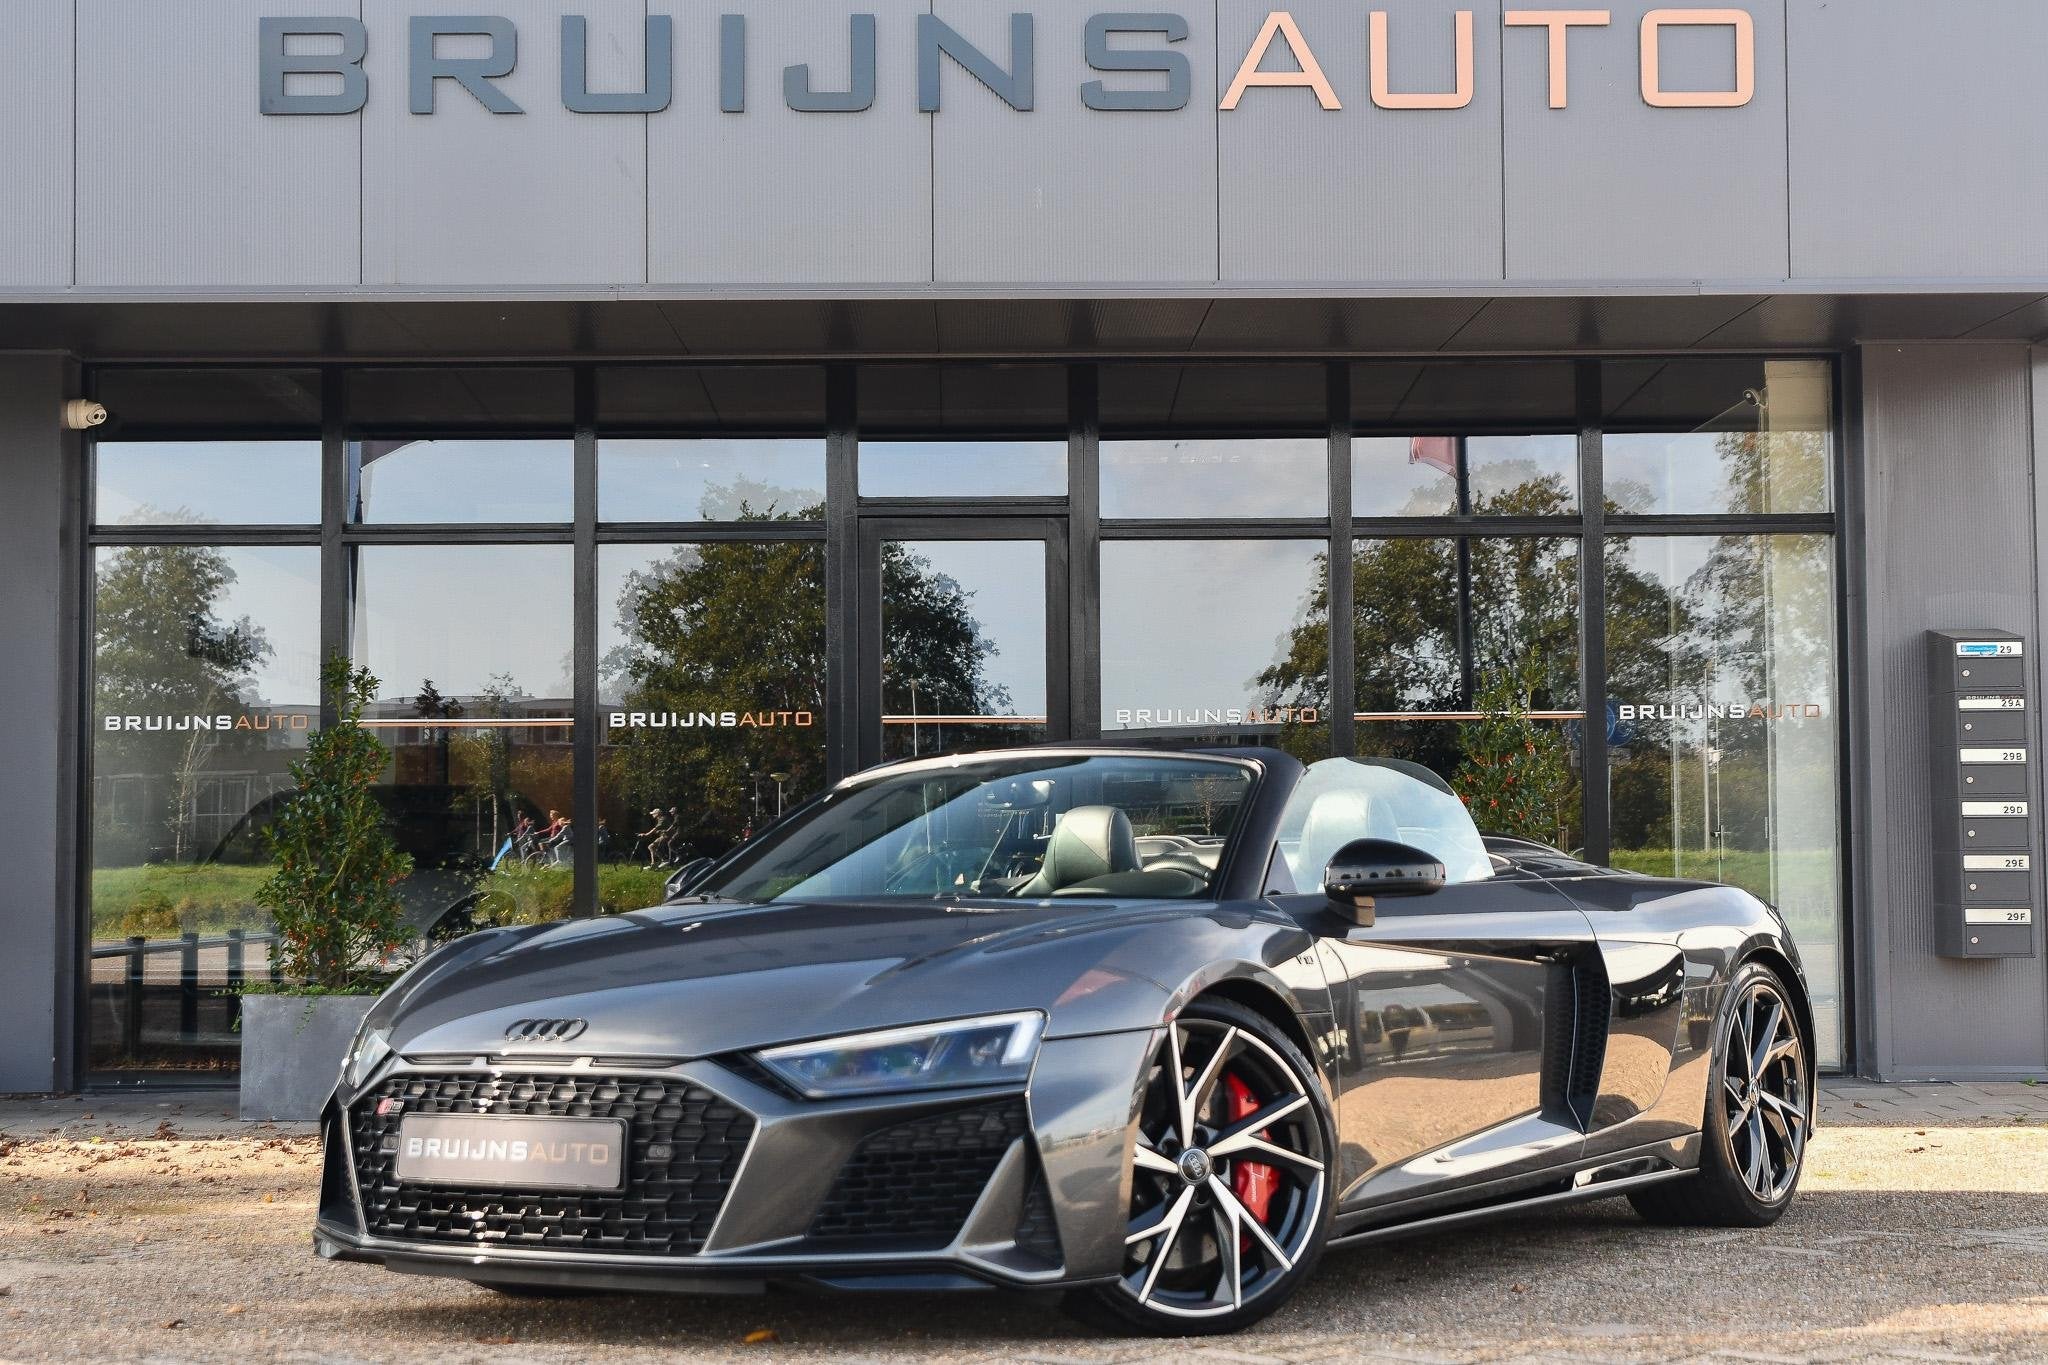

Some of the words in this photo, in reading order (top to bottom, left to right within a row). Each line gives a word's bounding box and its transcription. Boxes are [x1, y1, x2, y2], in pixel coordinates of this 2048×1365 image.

[260, 9, 1754, 116] BRUIJNSAUTO
[2000, 645, 2012, 654] 29
[2001, 699, 2021, 707] 29A
[1116, 708, 1318, 723] BRUIJNSAUTO
[1619, 704, 1820, 720] BRUIJNSAUTO
[105, 715, 308, 731] BRUIJNSAUTO
[609, 711, 812, 727] BRUIJNSAUTO
[2002, 752, 2022, 761] 29B
[2003, 806, 2023, 814] 29D
[2005, 859, 2024, 868] 29E
[2007, 912, 2026, 921] 29F
[407, 1137, 609, 1165] BRUIJNSAUTO
